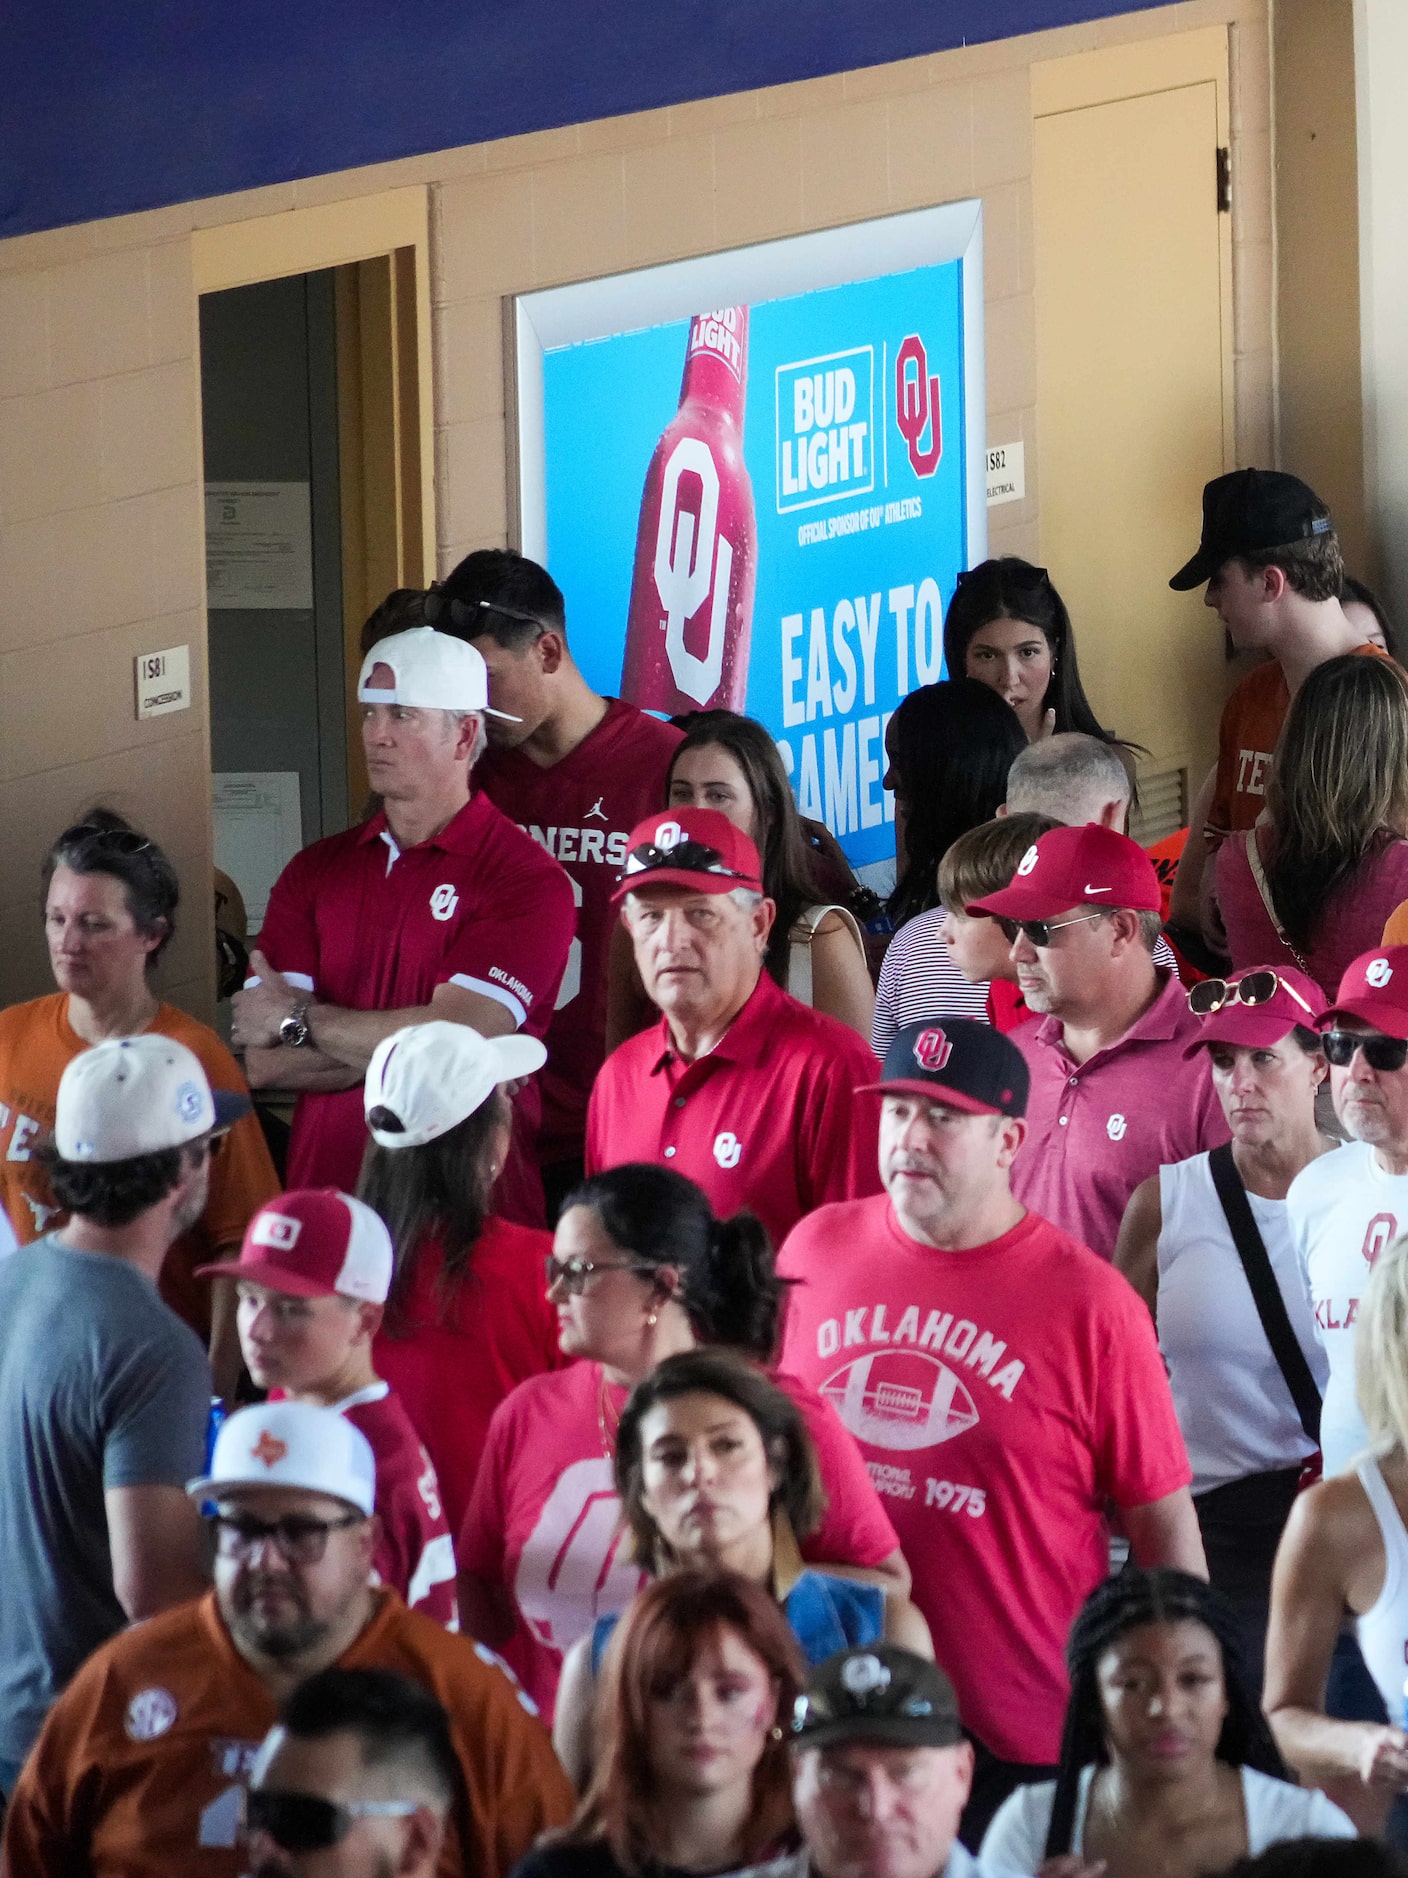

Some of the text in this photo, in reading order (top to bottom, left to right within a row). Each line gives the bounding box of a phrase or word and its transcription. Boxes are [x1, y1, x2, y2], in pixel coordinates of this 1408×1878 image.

[691, 320, 741, 369] LIGHT
[794, 367, 856, 434] BUD
[782, 421, 868, 496] LIGHT
[798, 520, 829, 547] OFFICIAL
[828, 510, 861, 540] SPONSOR
[885, 496, 922, 525] ATHLETICS
[781, 577, 944, 729] EASY TO
[429, 883, 460, 921] OU
[487, 966, 534, 1007] OKLAHOMA
[912, 1027, 954, 1072] OU
[712, 1131, 742, 1169] OU
[817, 1304, 1026, 1403] OKLAHOMA
[924, 1476, 988, 1518] 1975
